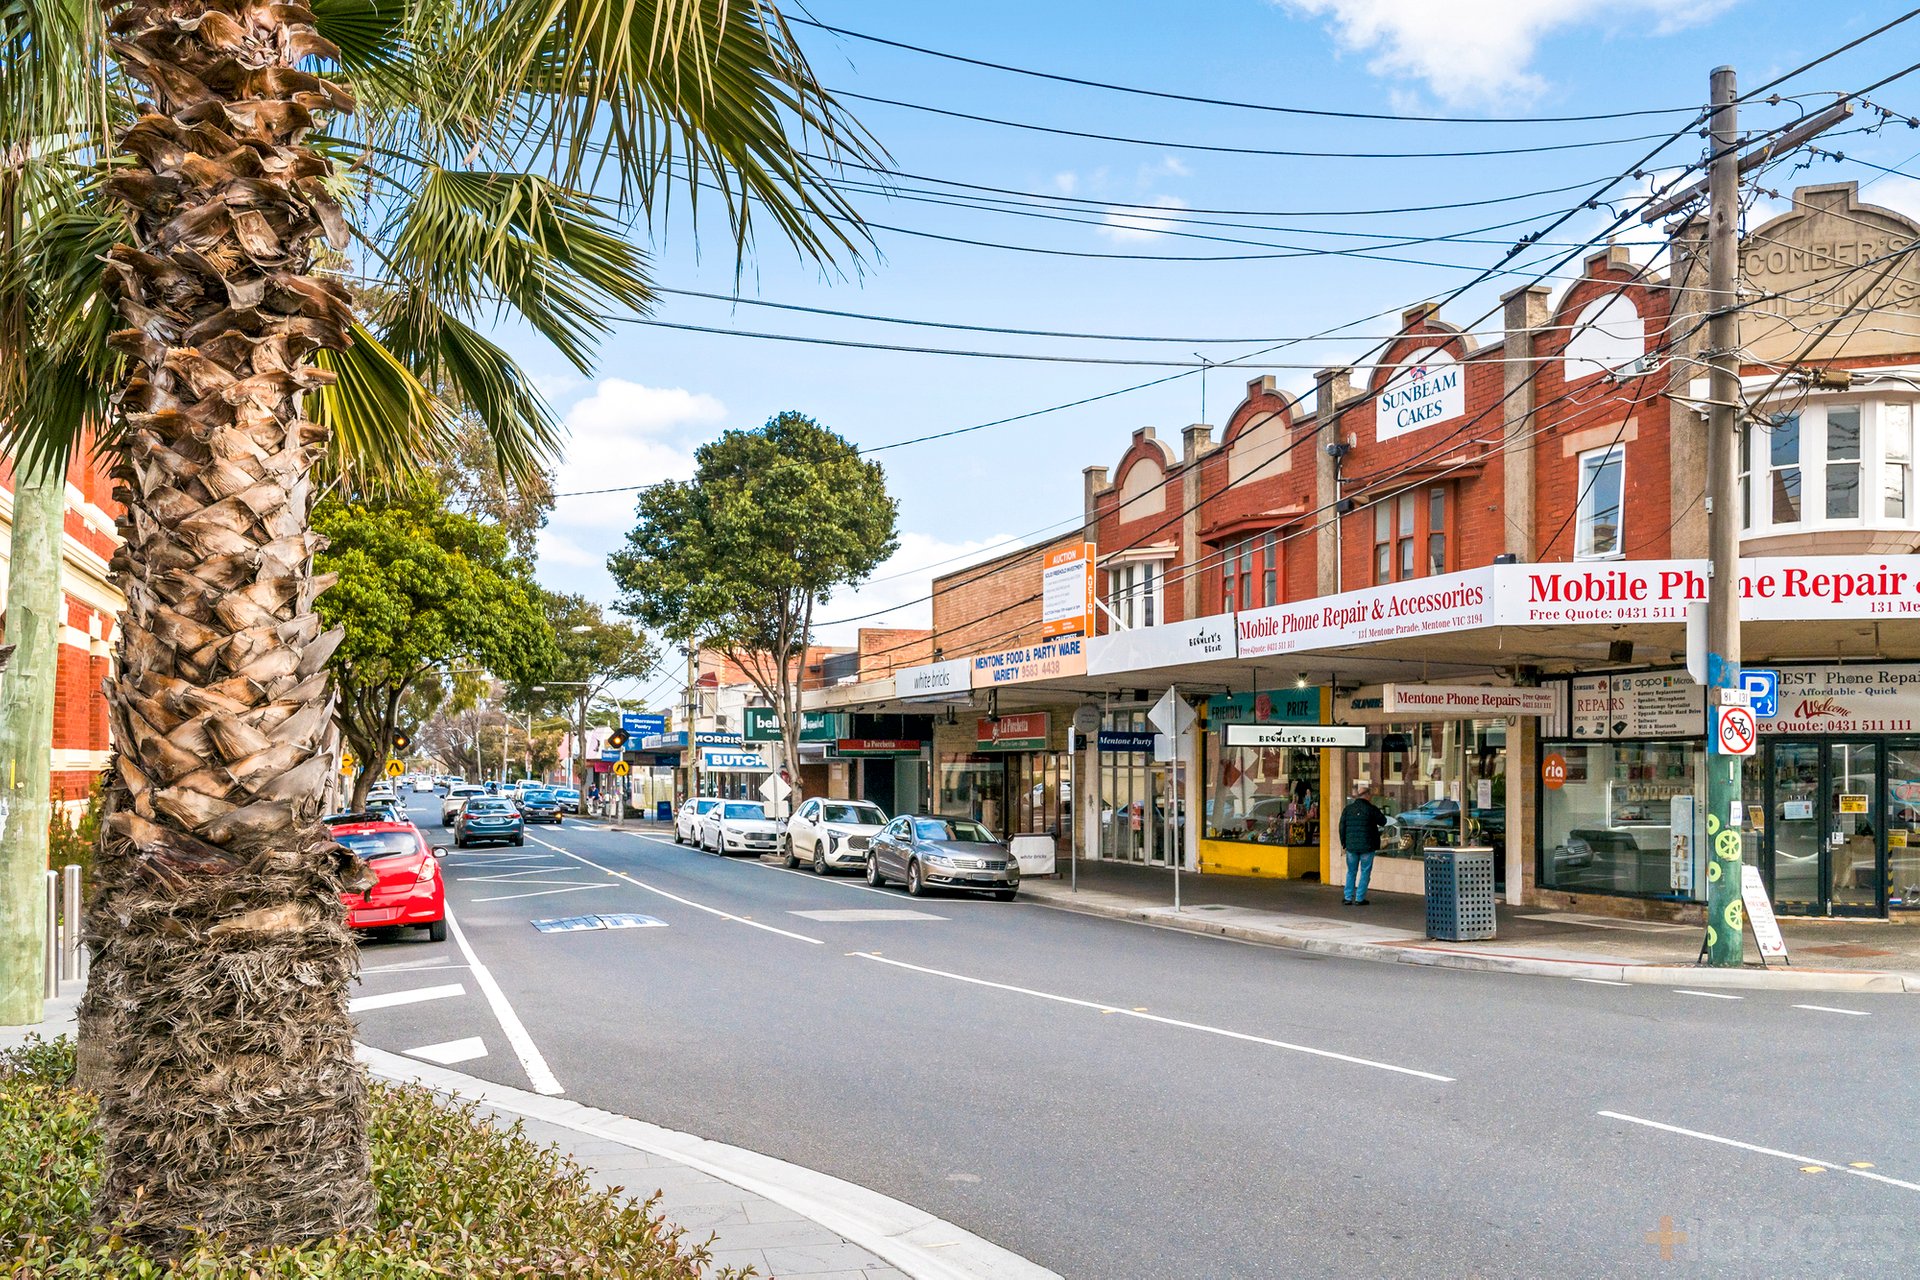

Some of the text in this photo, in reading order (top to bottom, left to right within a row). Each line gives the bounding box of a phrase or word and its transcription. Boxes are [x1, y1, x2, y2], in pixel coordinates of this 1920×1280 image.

[1738, 281, 1916, 320] UILDINGS
[1382, 371, 1456, 412] SUNBEAM
[1397, 400, 1443, 428] CAKES
[1052, 550, 1077, 565] AUCTION
[1528, 571, 1648, 602] Mobile
[1658, 570, 1776, 600] Phne
[1782, 564, 1908, 603] Repair
[1239, 582, 1484, 640] Mobile Phone Repair & Accessories
[1530, 609, 1561, 621] Free
[1565, 608, 1612, 622] Quote:
[1617, 607, 1647, 619] 0431
[1653, 606, 1678, 618] 511
[1871, 602, 1893, 612] 131
[1368, 625, 1395, 638] Mentone
[1421, 619, 1451, 631] Mentone
[1451, 616, 1467, 626] VIC
[1467, 613, 1483, 625] 3194
[975, 640, 1081, 670] MENTONE FOOD & PARTY WARE
[913, 669, 950, 689] white bricks
[993, 659, 1061, 682] VARIETY 9583 4438
[1826, 671, 1873, 684] Phone
[1879, 670, 1920, 685] Repa
[1397, 692, 1521, 708] Mentone Phone Repairs
[1799, 687, 1856, 696] Affordable
[1864, 687, 1897, 697] Quick
[1211, 700, 1309, 720] FRIENDLY PRIZE
[1577, 697, 1625, 712] REPAIRS
[1794, 697, 1852, 719] Welcome
[1001, 718, 1029, 733] La Porchetta
[1777, 720, 1824, 733] Quote:
[1827, 720, 1857, 731] 0431
[1862, 720, 1885, 731] 511
[1890, 719, 1912, 731] 111
[863, 740, 871, 748] La
[1099, 736, 1153, 747] Mentone Party
[1310, 735, 1336, 743] BREAD
[1545, 760, 1563, 778] ria
